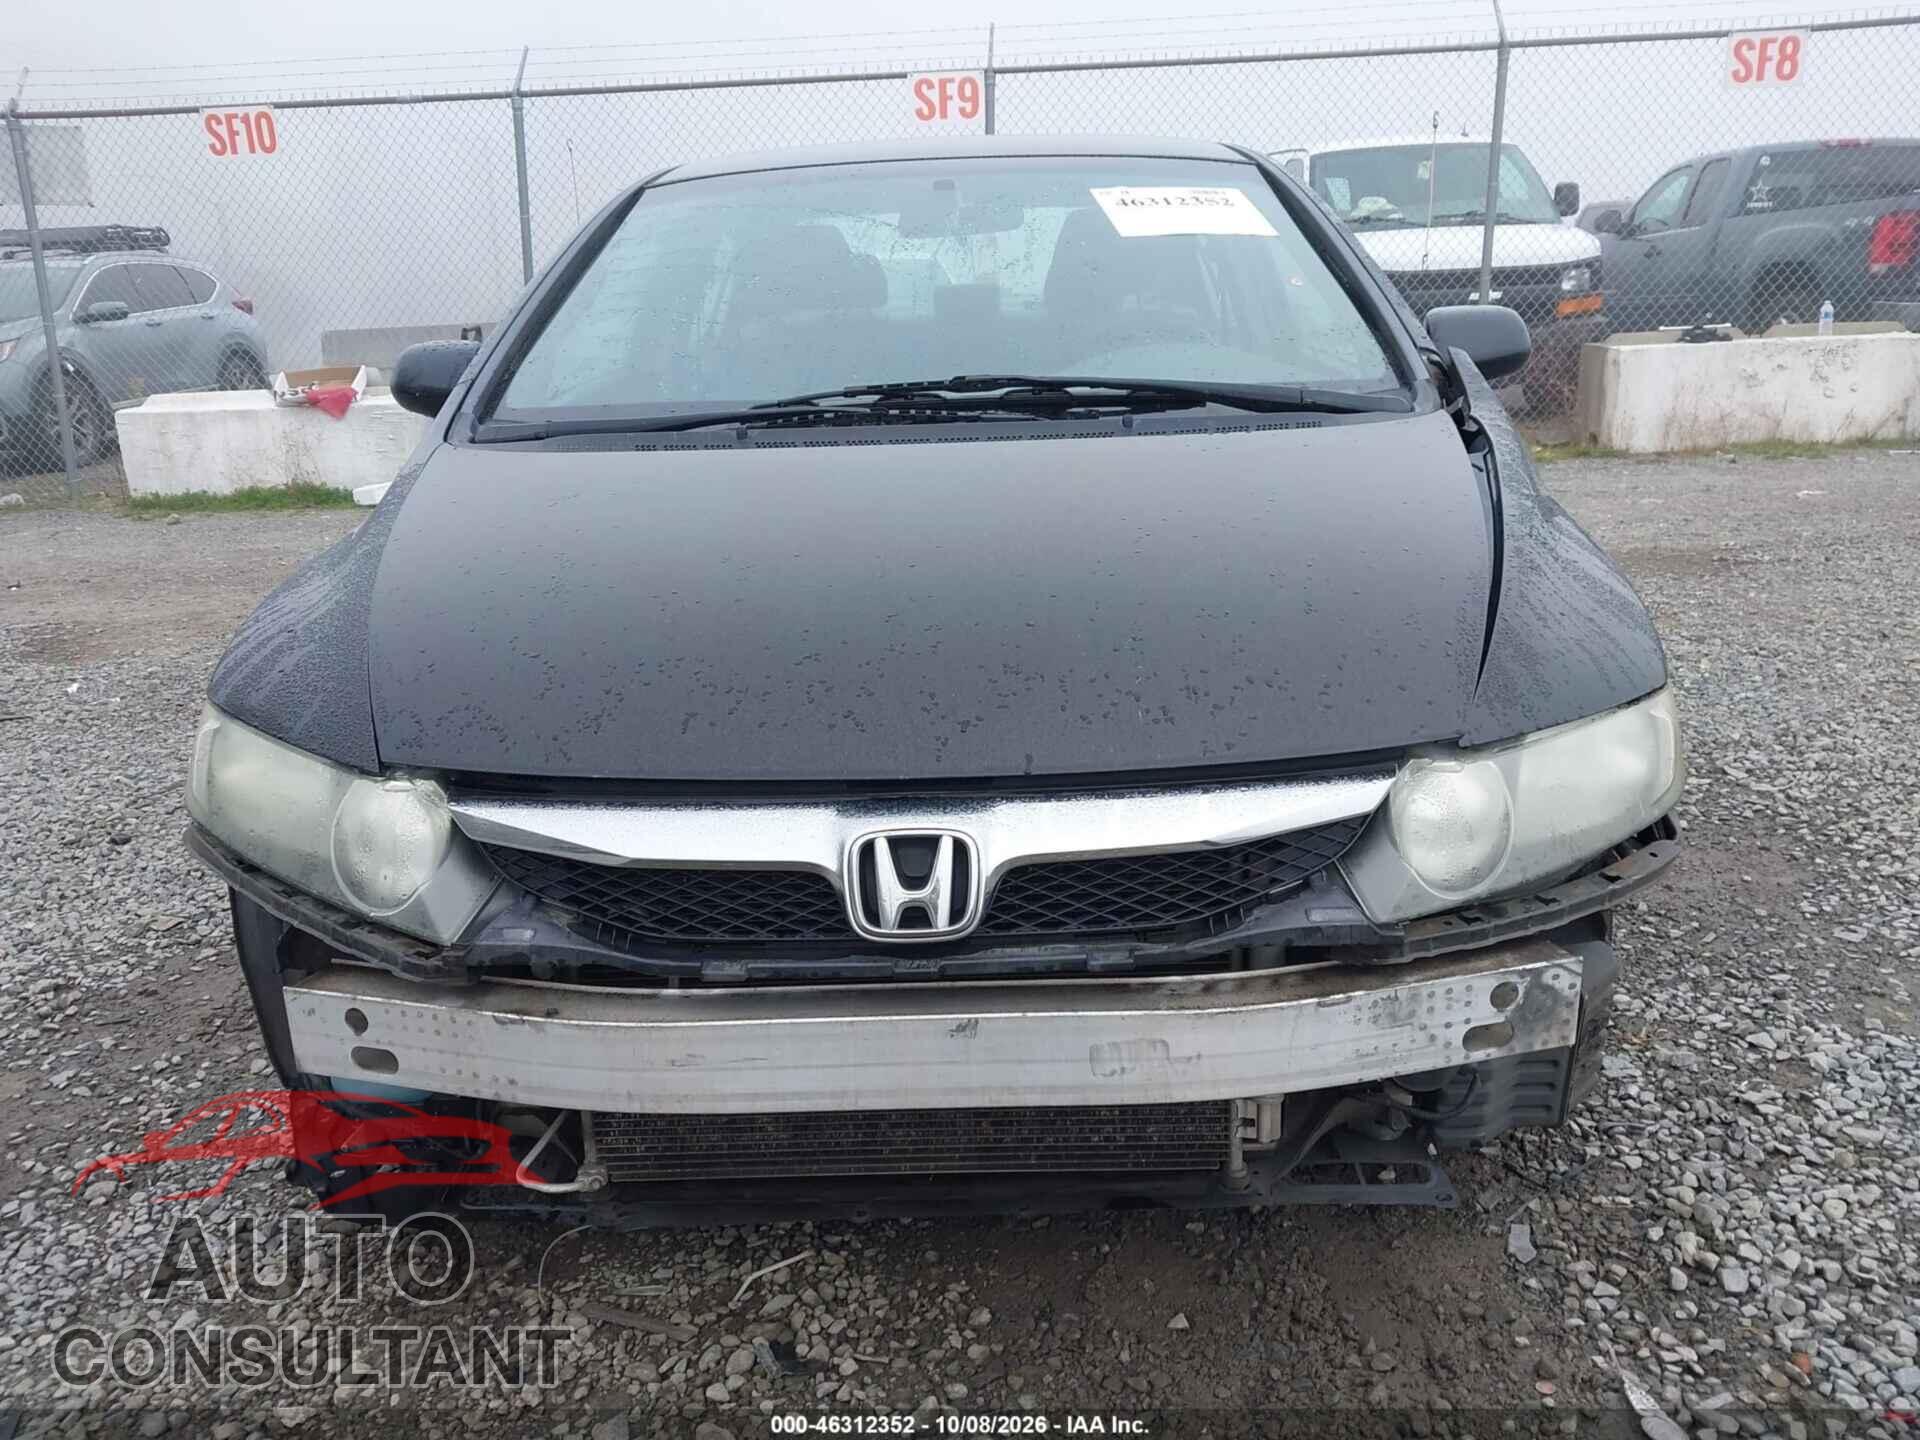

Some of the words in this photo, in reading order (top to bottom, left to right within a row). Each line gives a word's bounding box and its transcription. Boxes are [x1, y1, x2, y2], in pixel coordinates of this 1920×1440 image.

[1732, 35, 1800, 83] SF8
[914, 77, 980, 121] SF9
[205, 111, 277, 156] SF10
